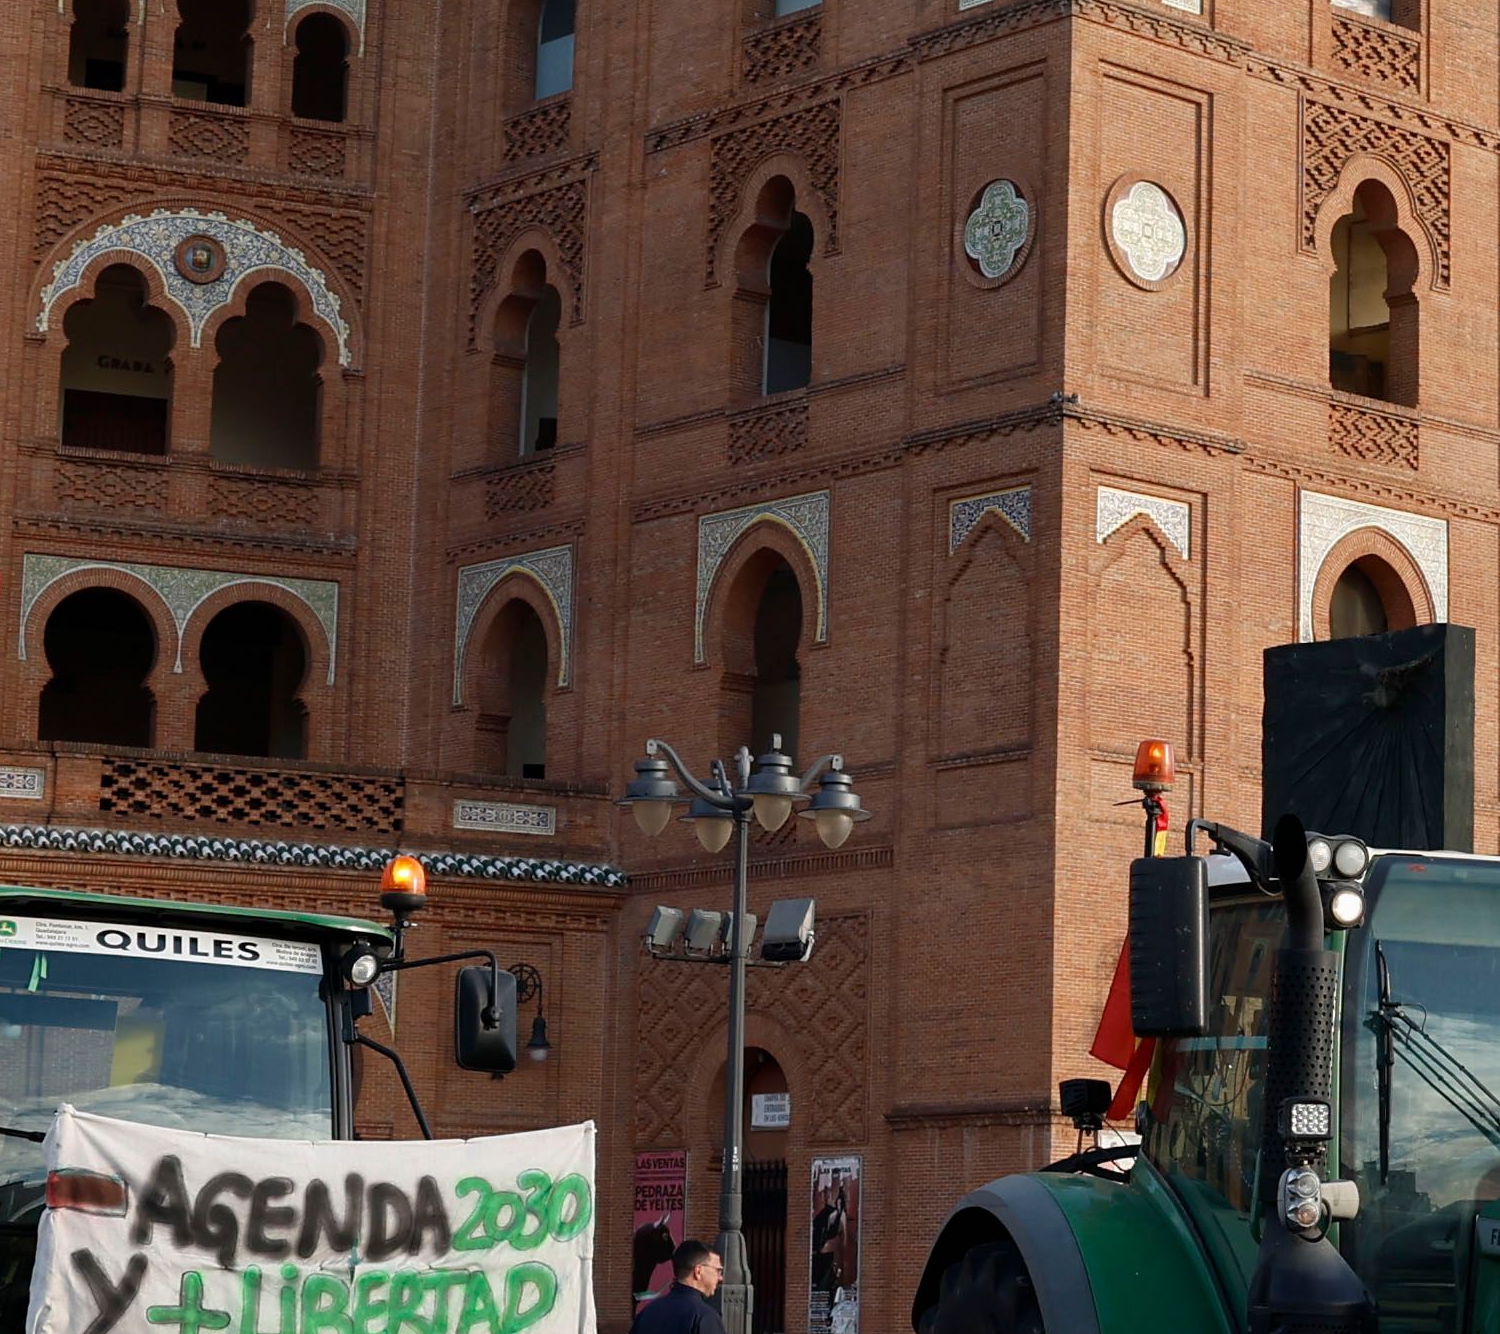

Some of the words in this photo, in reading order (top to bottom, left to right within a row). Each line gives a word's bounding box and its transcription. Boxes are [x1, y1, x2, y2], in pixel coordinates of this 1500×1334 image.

[96, 929, 260, 962] QUILES
[650, 1158, 685, 1168] VENTAS
[636, 1184, 683, 1198] PEDRAZA
[130, 1154, 453, 1267] AGENDA
[450, 1168, 592, 1254] 2030
[636, 1199, 647, 1211] DE
